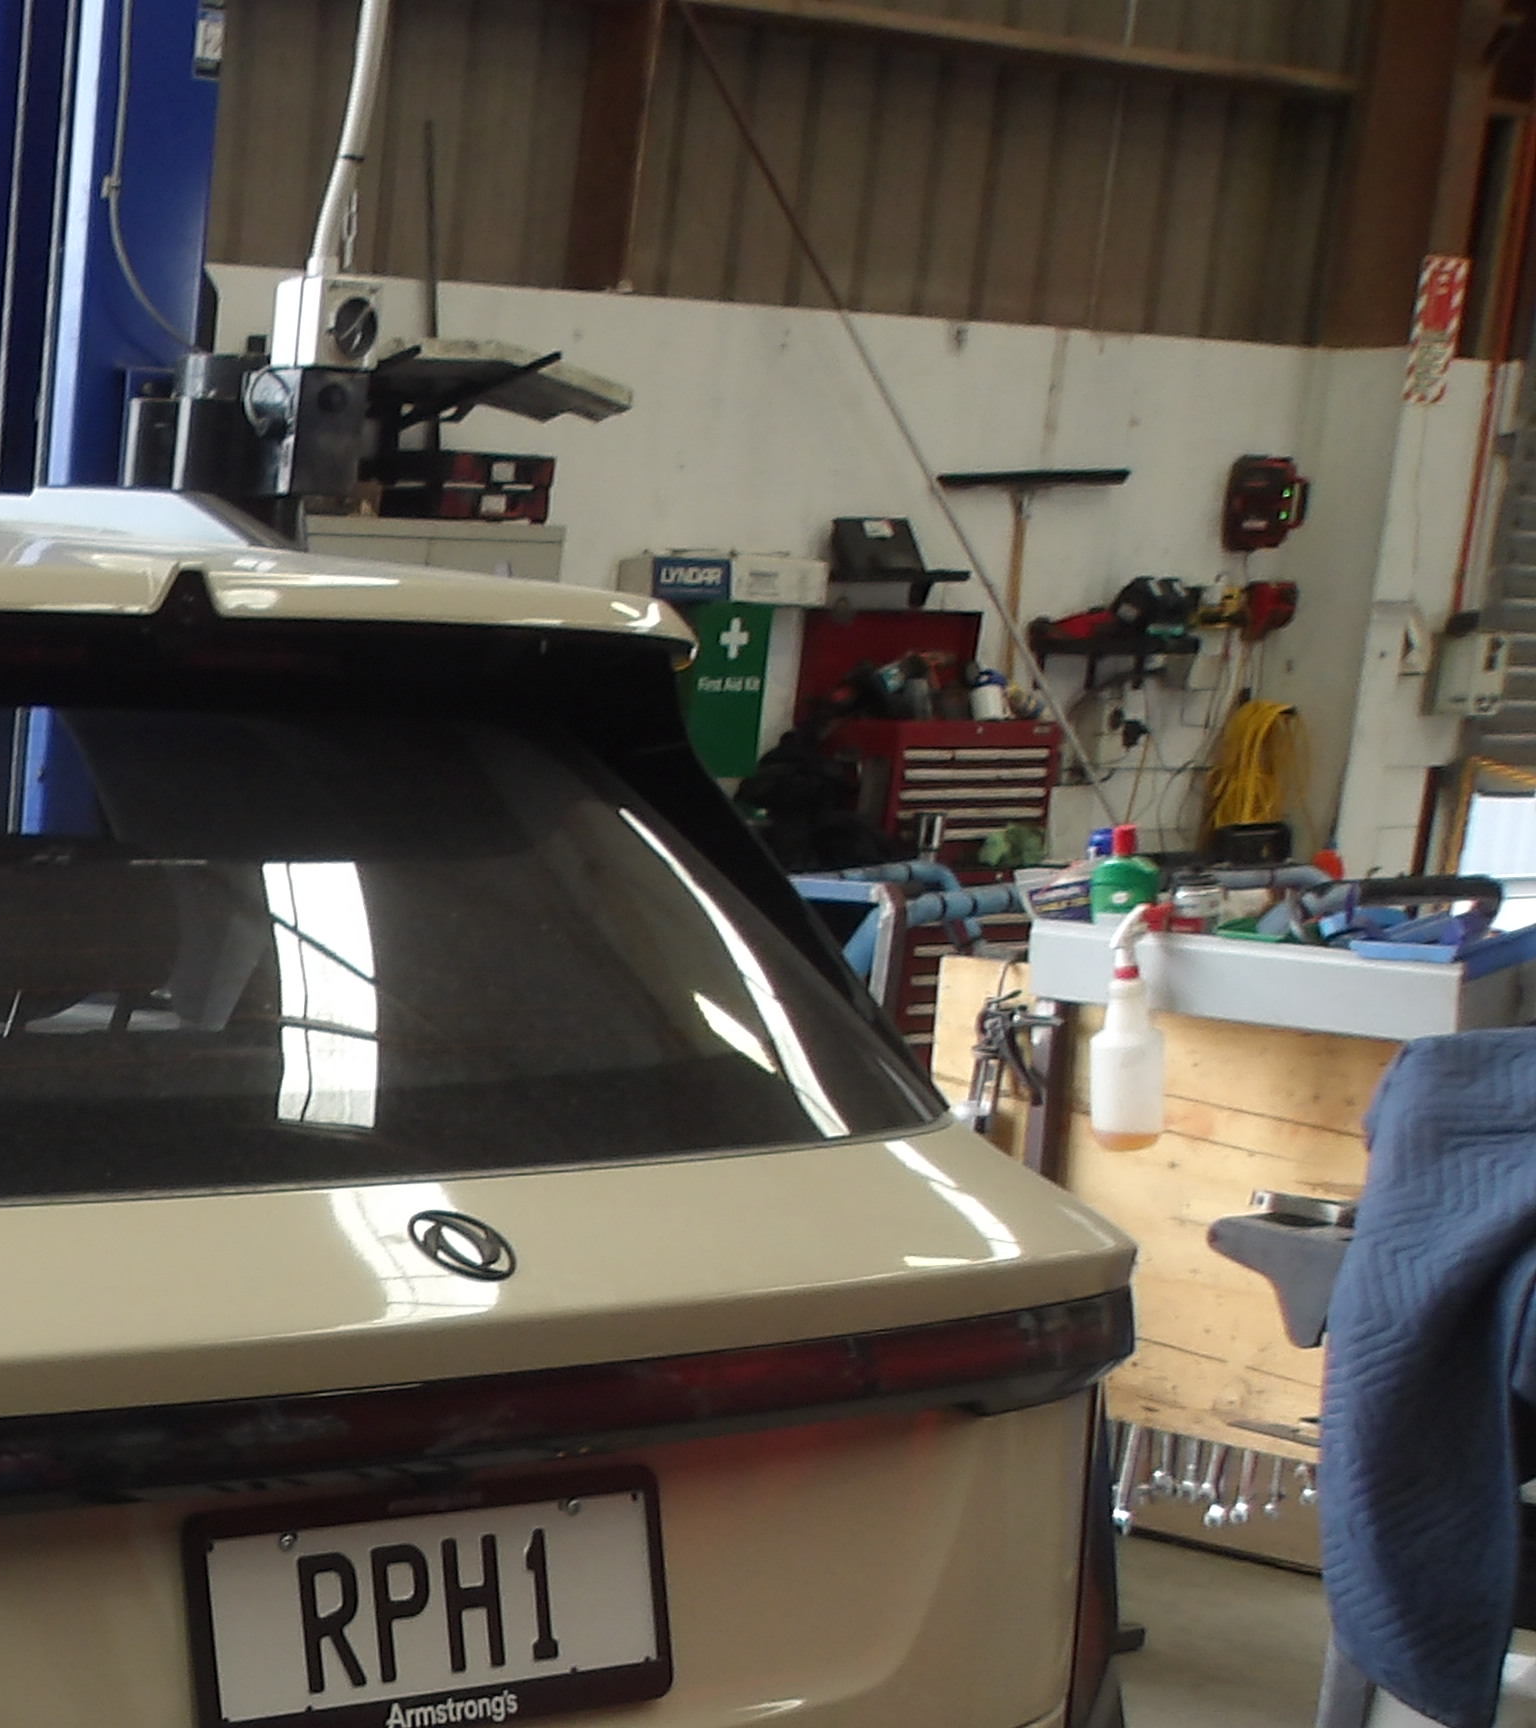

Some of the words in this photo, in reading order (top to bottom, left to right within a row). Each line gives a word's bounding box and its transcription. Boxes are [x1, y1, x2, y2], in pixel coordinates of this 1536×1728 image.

[697, 676, 723, 693] First
[723, 676, 743, 692] Aid
[744, 676, 762, 692] Kit
[297, 1527, 559, 1694] RPH1
